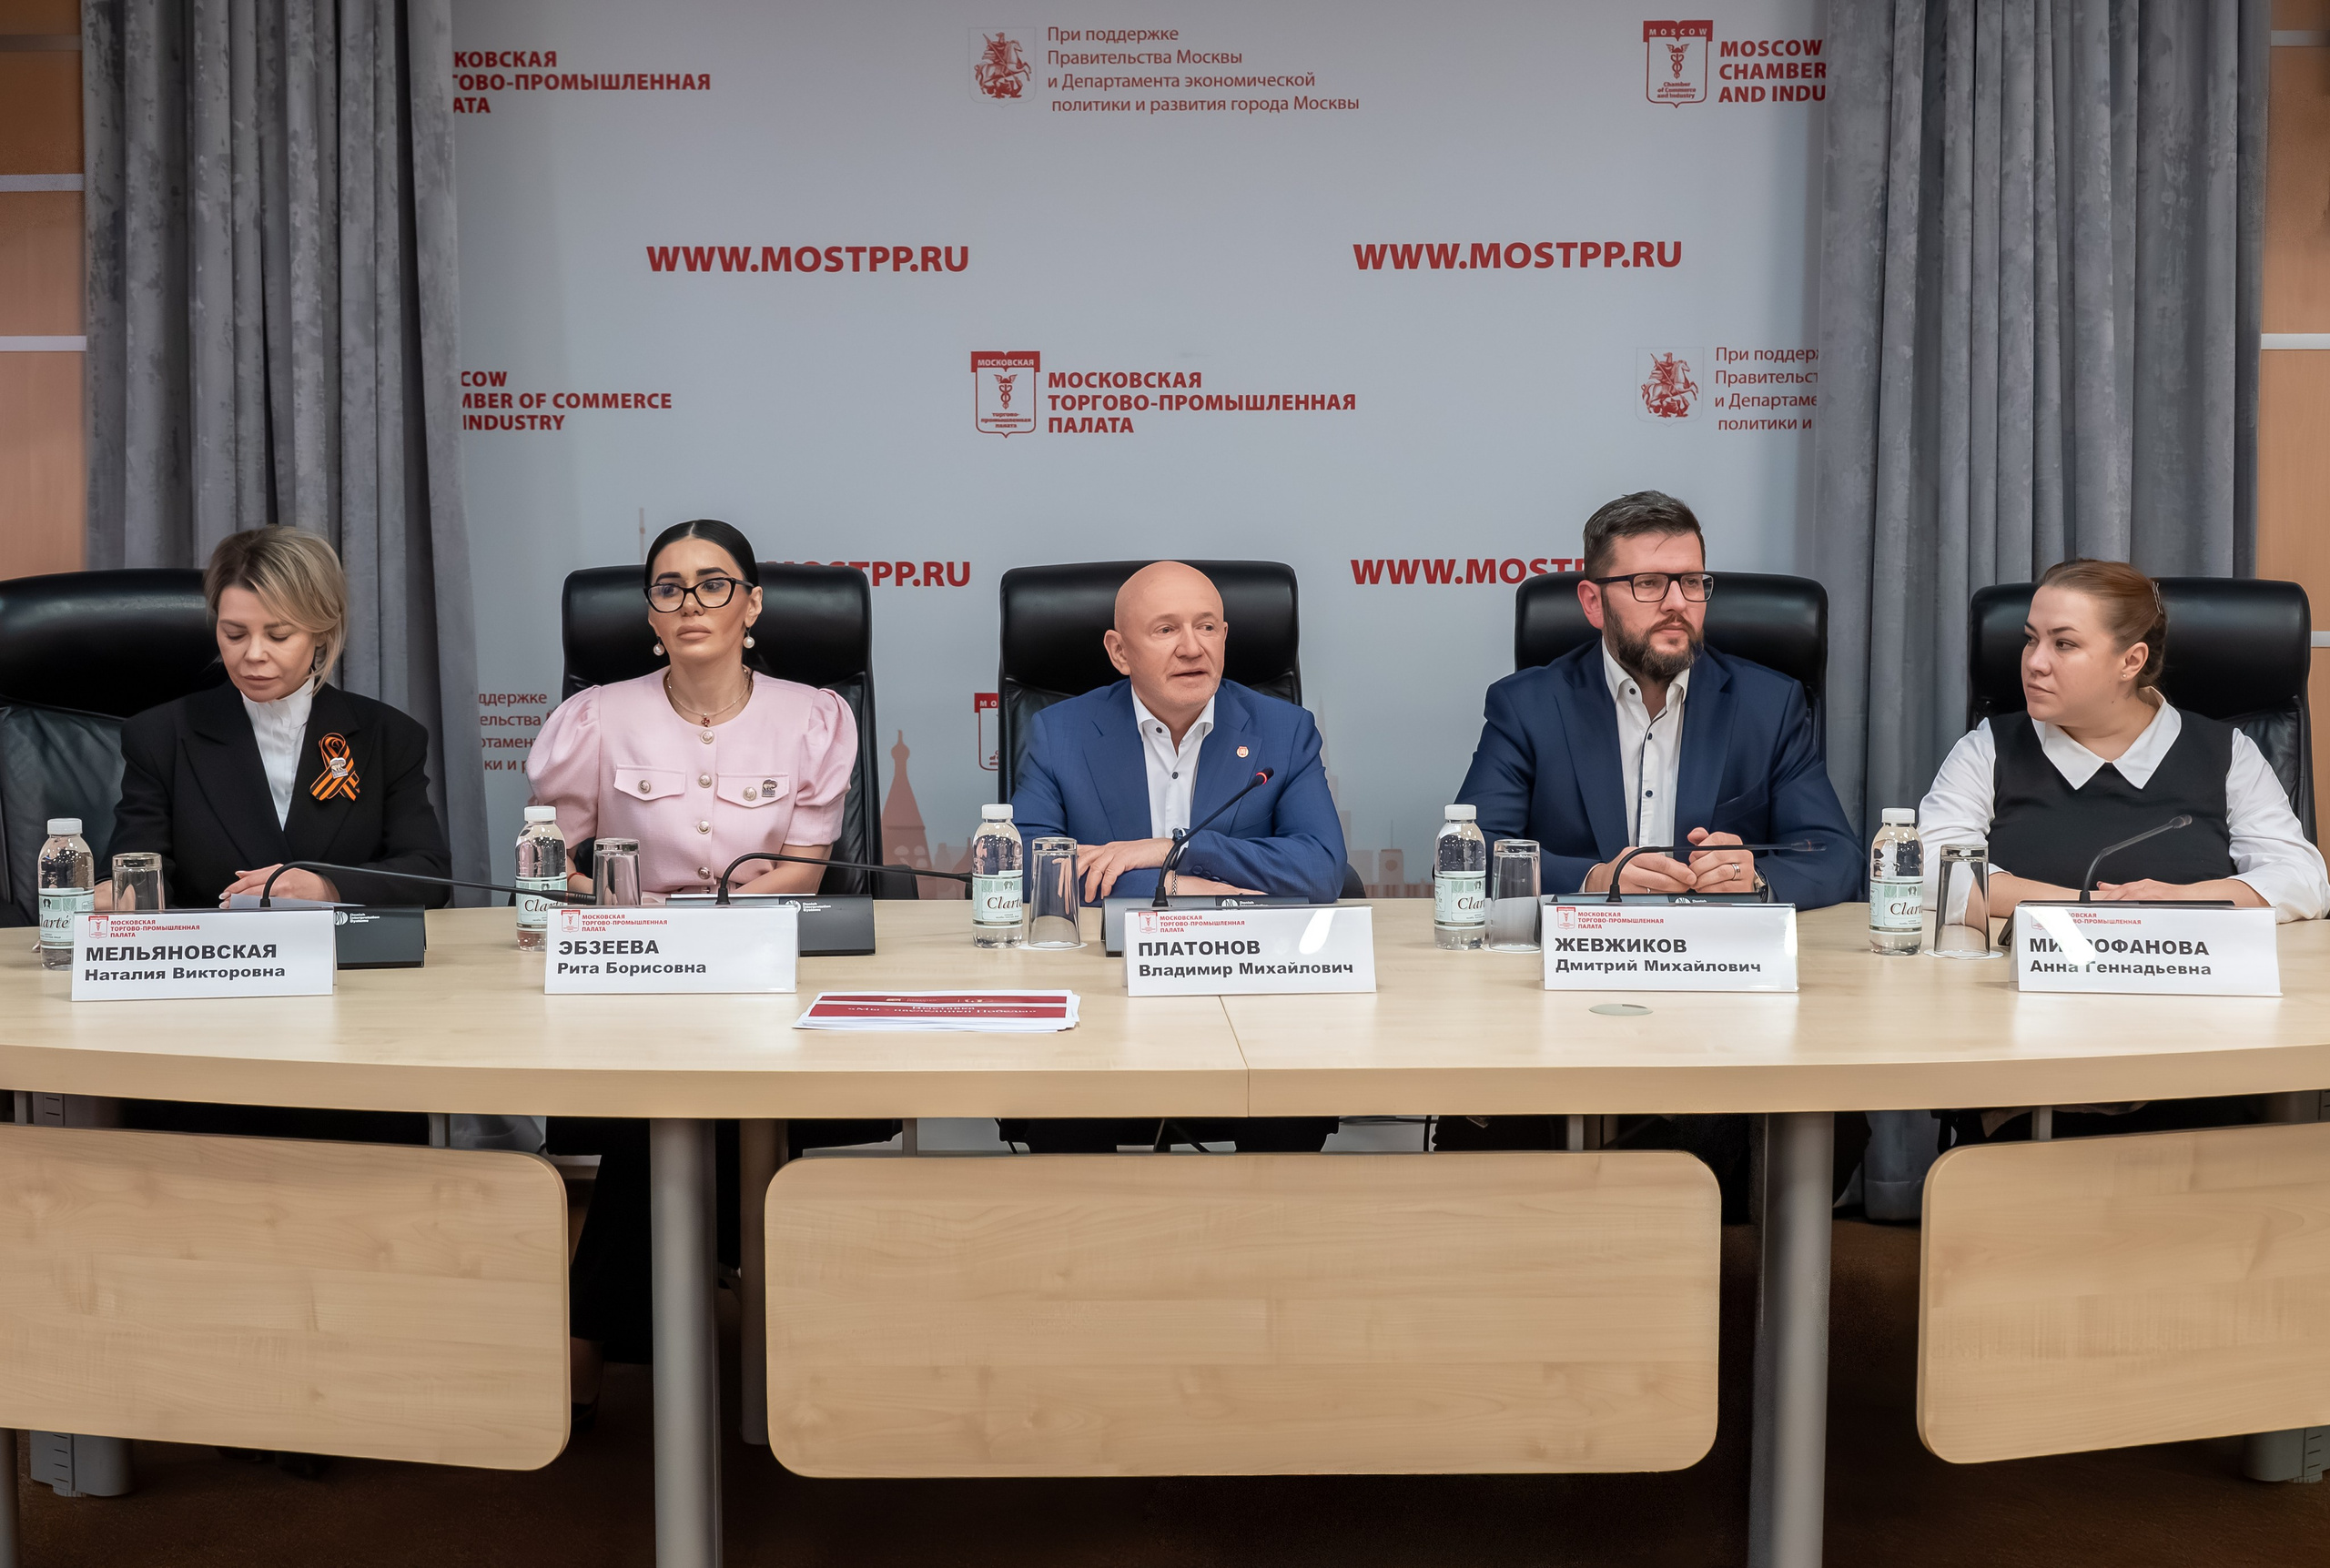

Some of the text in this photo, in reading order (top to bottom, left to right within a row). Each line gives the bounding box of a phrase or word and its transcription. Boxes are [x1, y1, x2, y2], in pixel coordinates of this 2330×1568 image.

[1048, 26, 1180, 45] При поддержке
[1720, 39, 1823, 57] MOSCOW
[1048, 49, 1242, 68] Правительства Москвы
[1718, 62, 1827, 80] CHAMBER
[1048, 72, 1315, 91] и Департамента экономической
[1717, 86, 1766, 103] AND
[1052, 96, 1359, 115] политики и развития города Москвы
[646, 246, 969, 273] WWW.MOSTPP.RU
[1352, 241, 1683, 270] WWW.MOSTPP.RU
[1716, 347, 1819, 364] При поддер
[1048, 372, 1201, 389] МОСКОВСКАЯ
[519, 393, 546, 409] OF
[552, 393, 672, 409] COMMERCE
[1048, 394, 1356, 411] ТОРГОВО-ПРОМЫШЛЕННАЯ
[1715, 397, 1725, 408] и
[462, 415, 565, 430] INDUSTRY
[1048, 417, 1134, 434] ПАЛАТА
[1718, 419, 1812, 430] политики и
[507, 760, 516, 770] и
[86, 944, 277, 961] МЕЛЬЯНОВСКАЯ
[559, 940, 660, 955] ЭБЗЕЕВА
[1139, 940, 1261, 956] ПЛАТОНОВ
[1555, 938, 1687, 953] ЖЕВЖИКОВ
[2030, 938, 2210, 956] МИОФАНОВА
[85, 966, 286, 981] Наталия Викторовна
[557, 962, 706, 976] Рита Борисовна
[1139, 962, 1353, 978] Владимир Михайлович
[1555, 959, 1761, 974] Дмитрий Михайлович
[2030, 960, 2212, 976] Анна Геннадьевна
